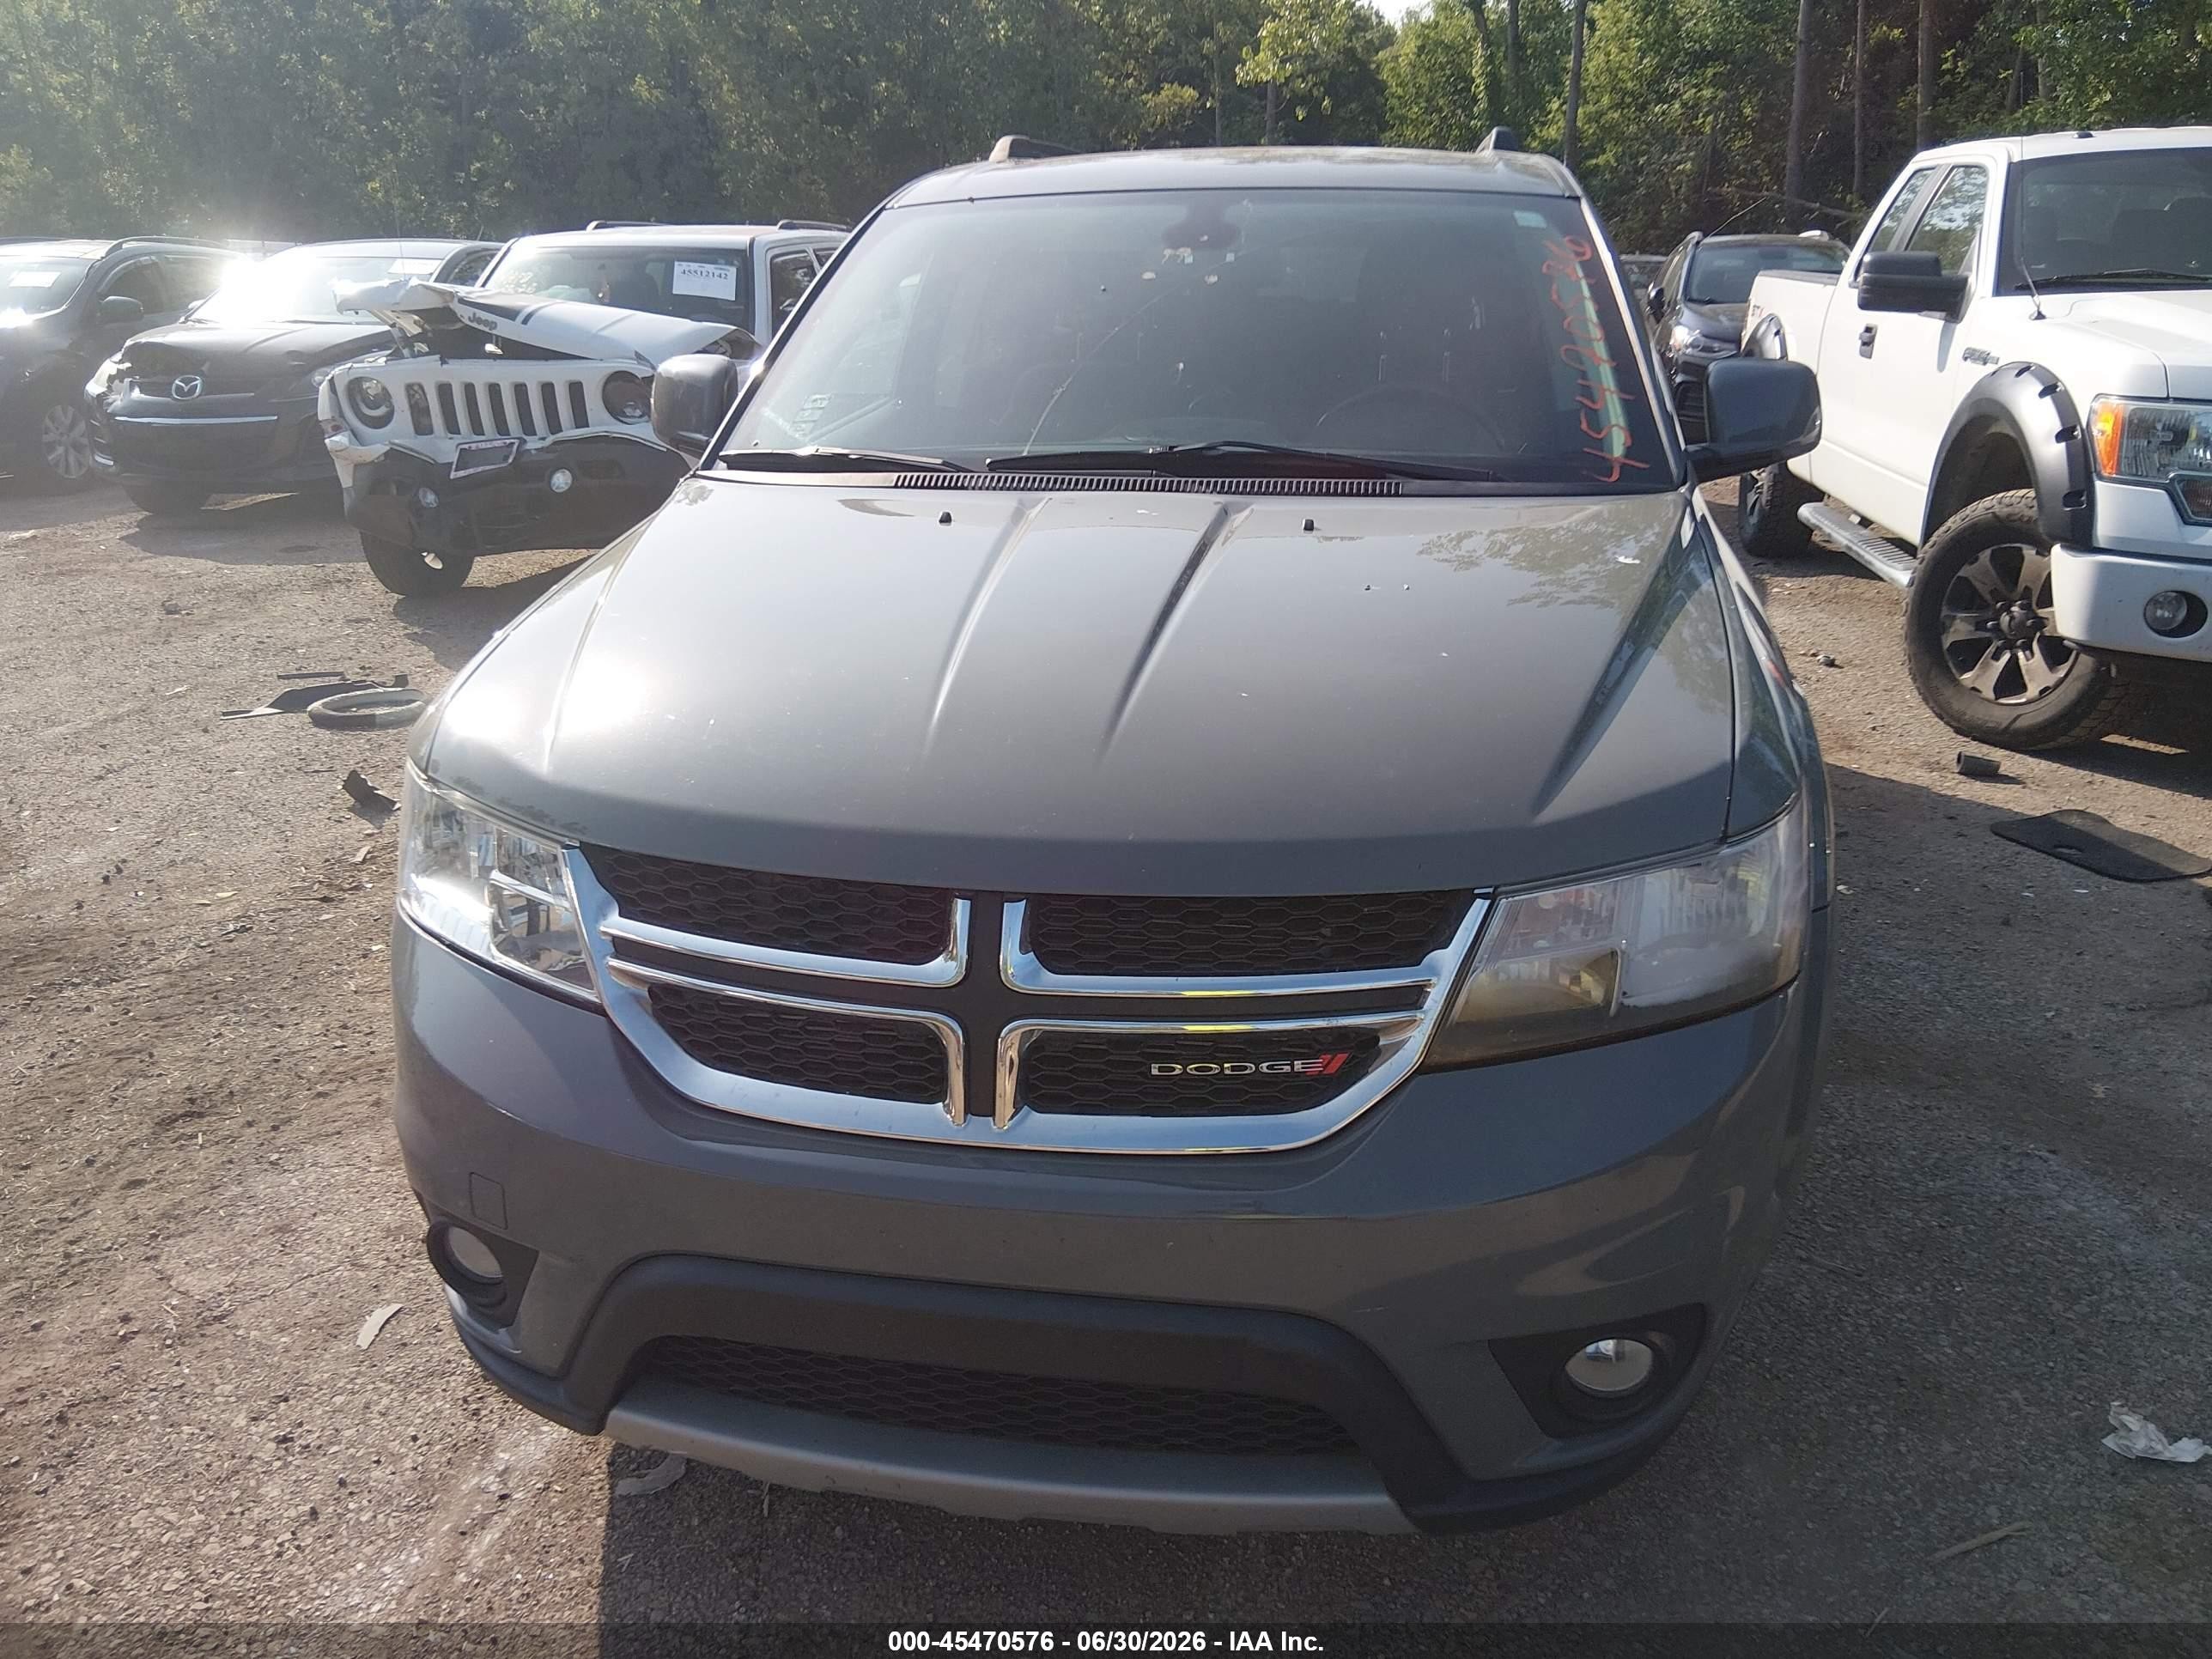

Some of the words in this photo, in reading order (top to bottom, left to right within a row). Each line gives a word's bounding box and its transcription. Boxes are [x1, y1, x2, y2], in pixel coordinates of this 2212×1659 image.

[681, 269, 729, 280] 45512142
[468, 312, 498, 331] Jeep
[1541, 234, 1651, 483] 45470576
[1151, 1059, 1325, 1076] DODGE
